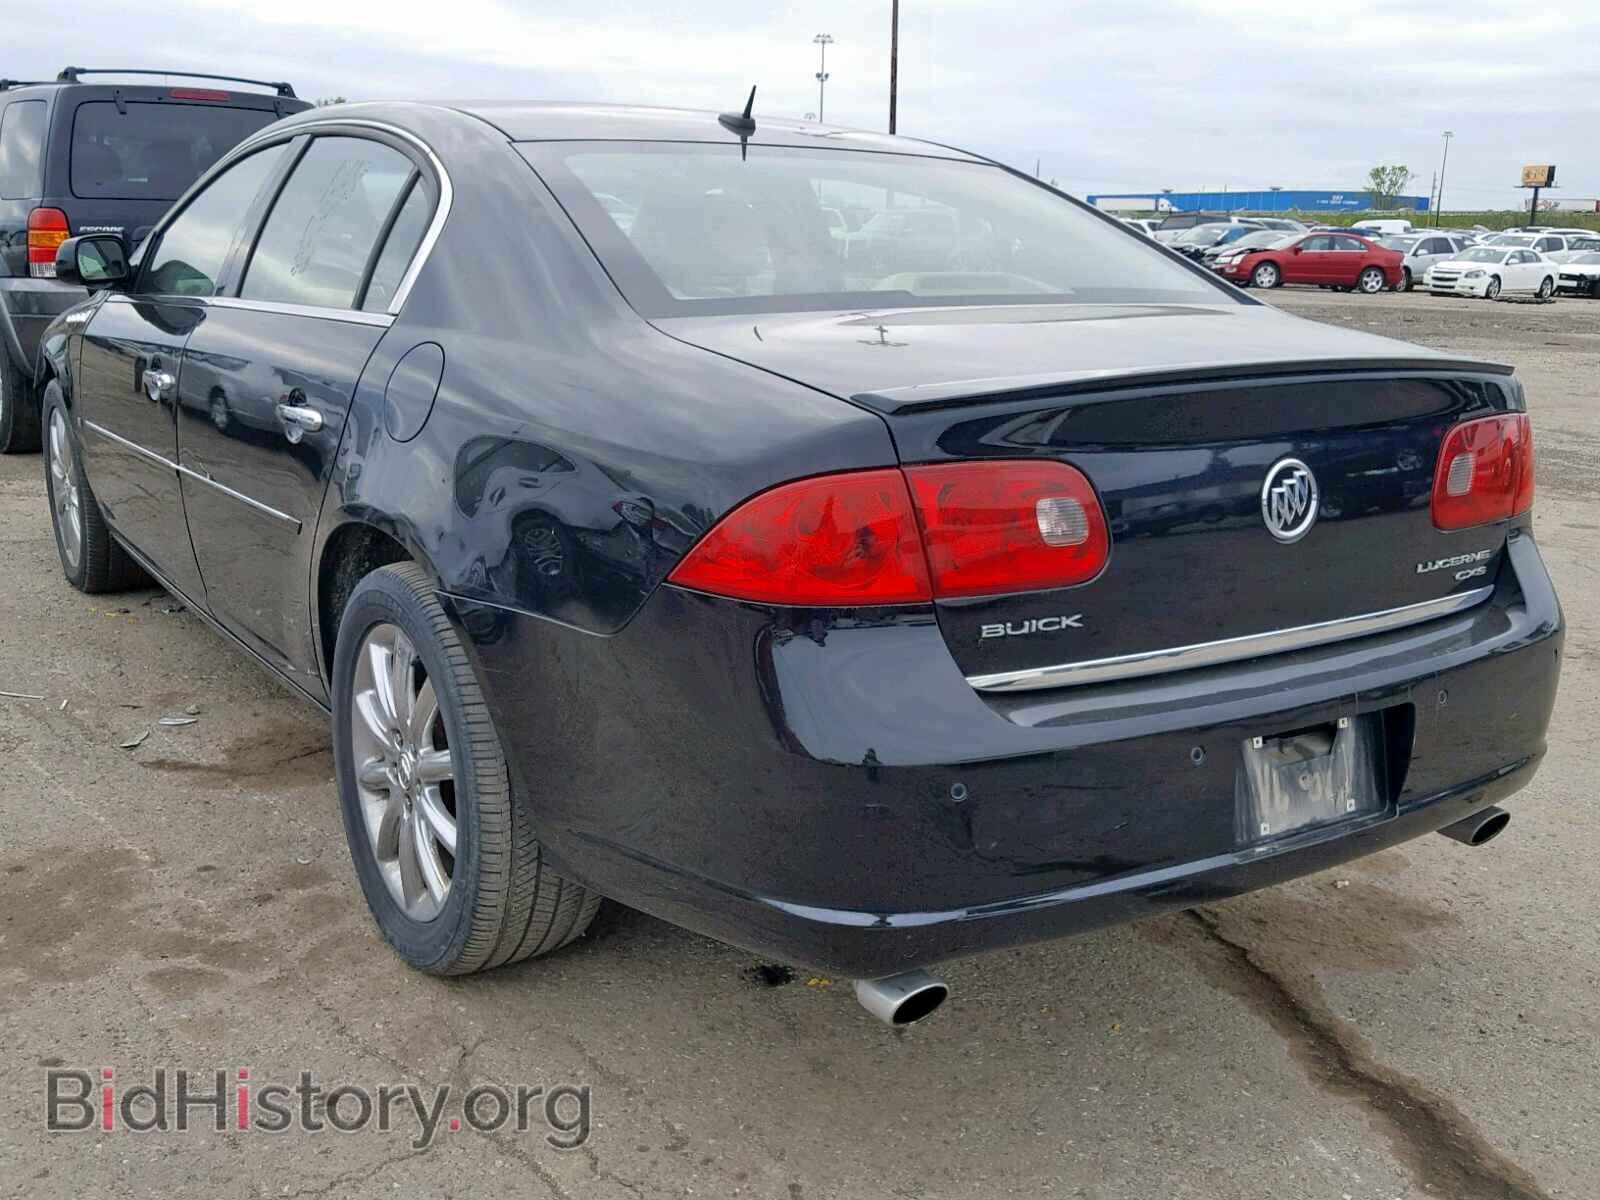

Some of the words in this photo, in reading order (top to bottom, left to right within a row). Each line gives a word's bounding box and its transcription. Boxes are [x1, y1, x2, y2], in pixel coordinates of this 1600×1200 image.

[1416, 549, 1491, 573] LUCERNE
[1454, 566, 1487, 581] CXS
[980, 613, 1084, 638] BUICK
